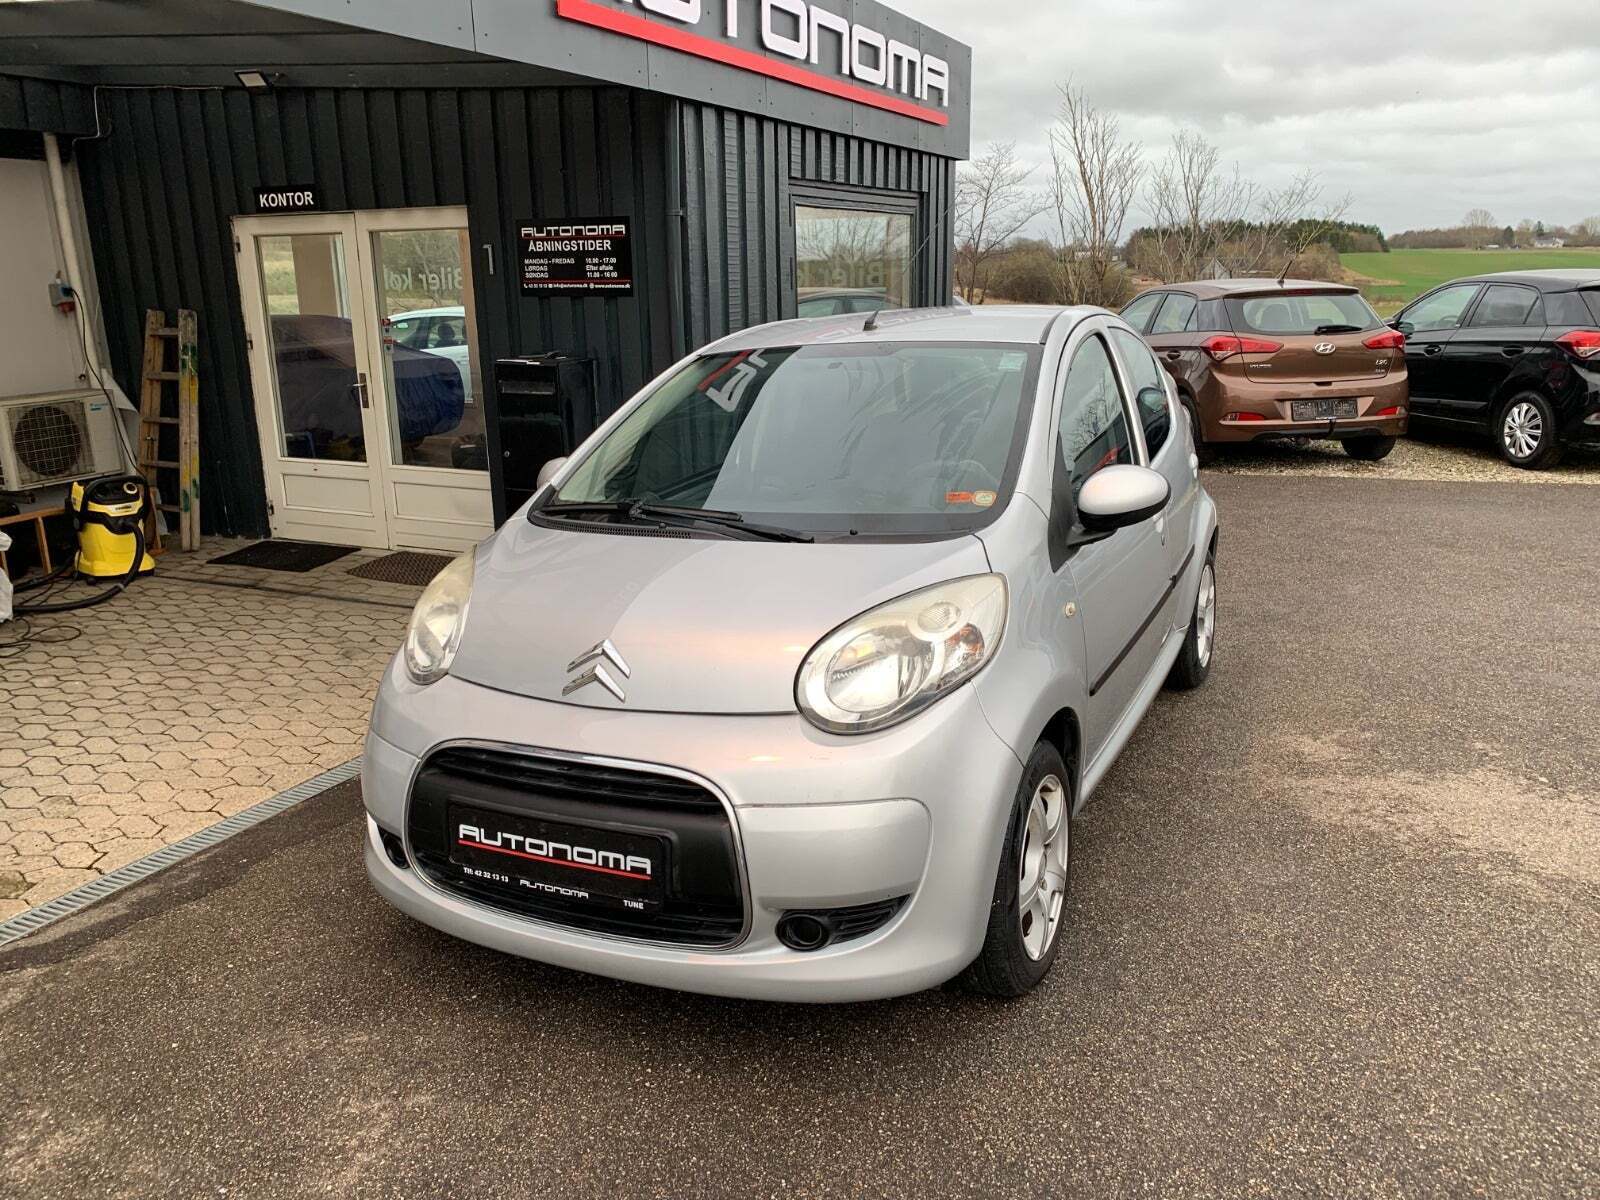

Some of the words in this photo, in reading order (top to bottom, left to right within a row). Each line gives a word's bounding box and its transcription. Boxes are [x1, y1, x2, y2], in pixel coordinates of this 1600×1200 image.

[622, 0, 949, 107] ONOMA
[259, 191, 314, 208] KONTOR
[521, 224, 626, 238] AUTONOMA
[528, 239, 612, 252] ÅBNINGSTIDER
[458, 823, 652, 875] AUTONOMA
[474, 869, 483, 877] 42
[483, 871, 491, 879] 32
[500, 875, 509, 883] 13
[519, 879, 589, 900] AUTONOMA
[623, 899, 645, 910] TUNE
